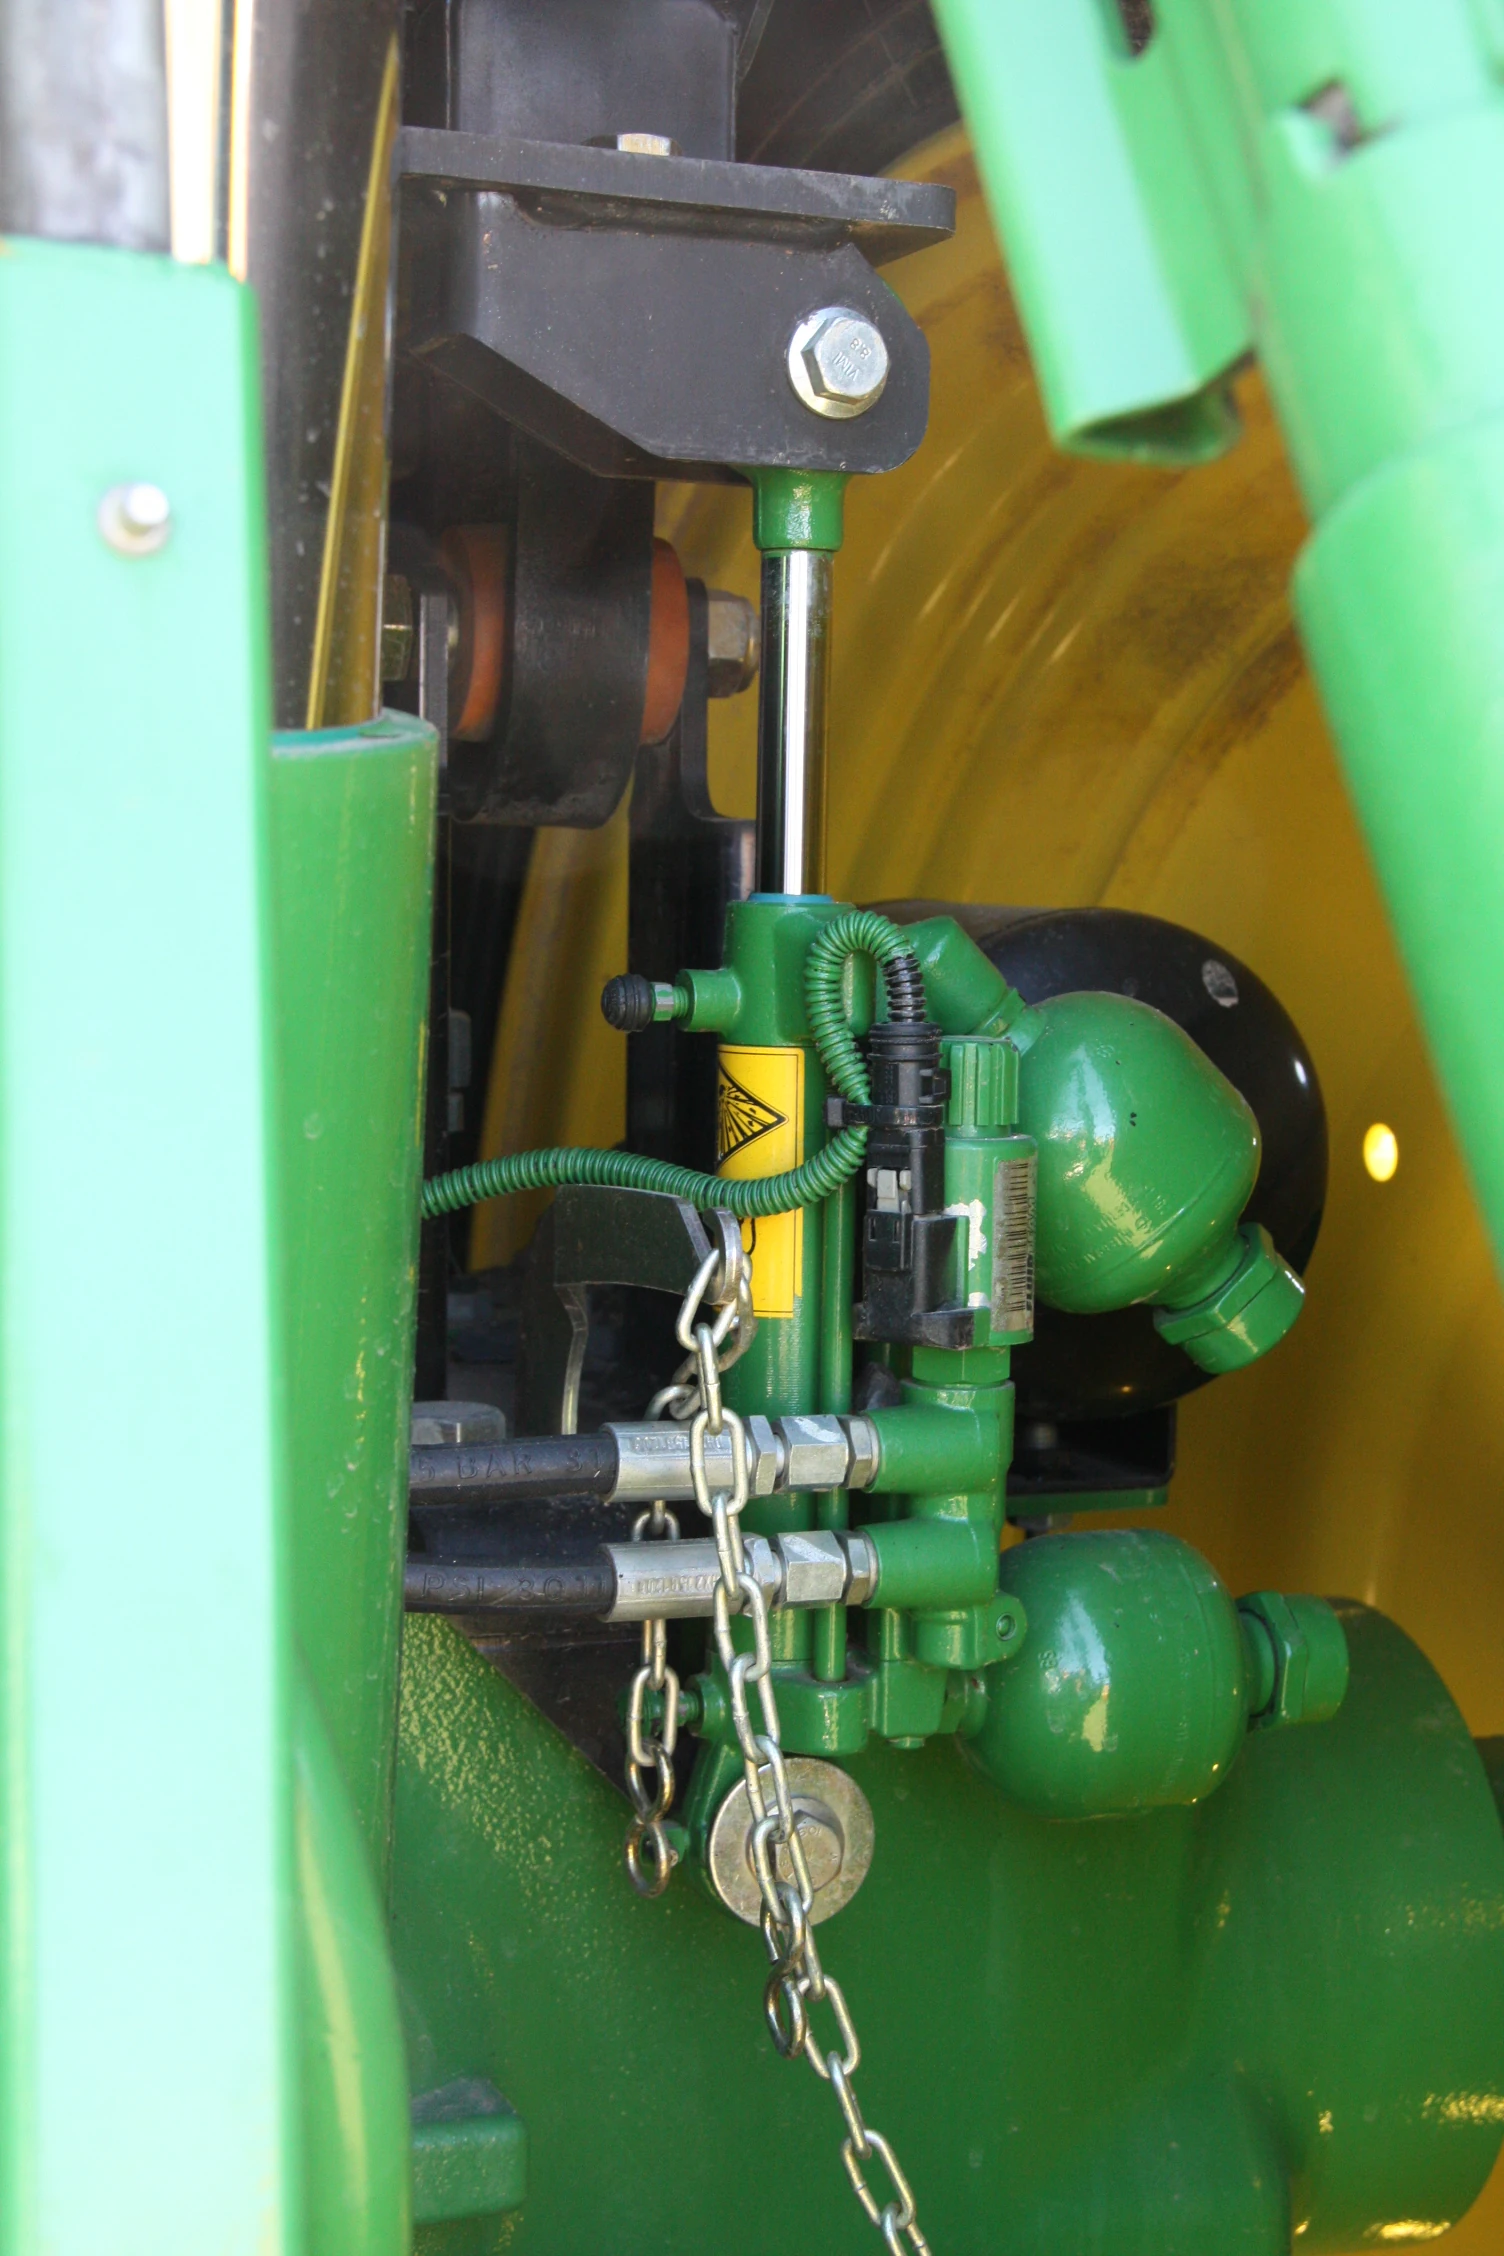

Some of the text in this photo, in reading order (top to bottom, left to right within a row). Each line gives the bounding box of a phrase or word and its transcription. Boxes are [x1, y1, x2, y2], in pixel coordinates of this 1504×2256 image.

[850, 338, 872, 360] 8.8
[833, 352, 860, 381] VIMI
[458, 1450, 533, 1479] BAR
[421, 1571, 485, 1601] PSI
